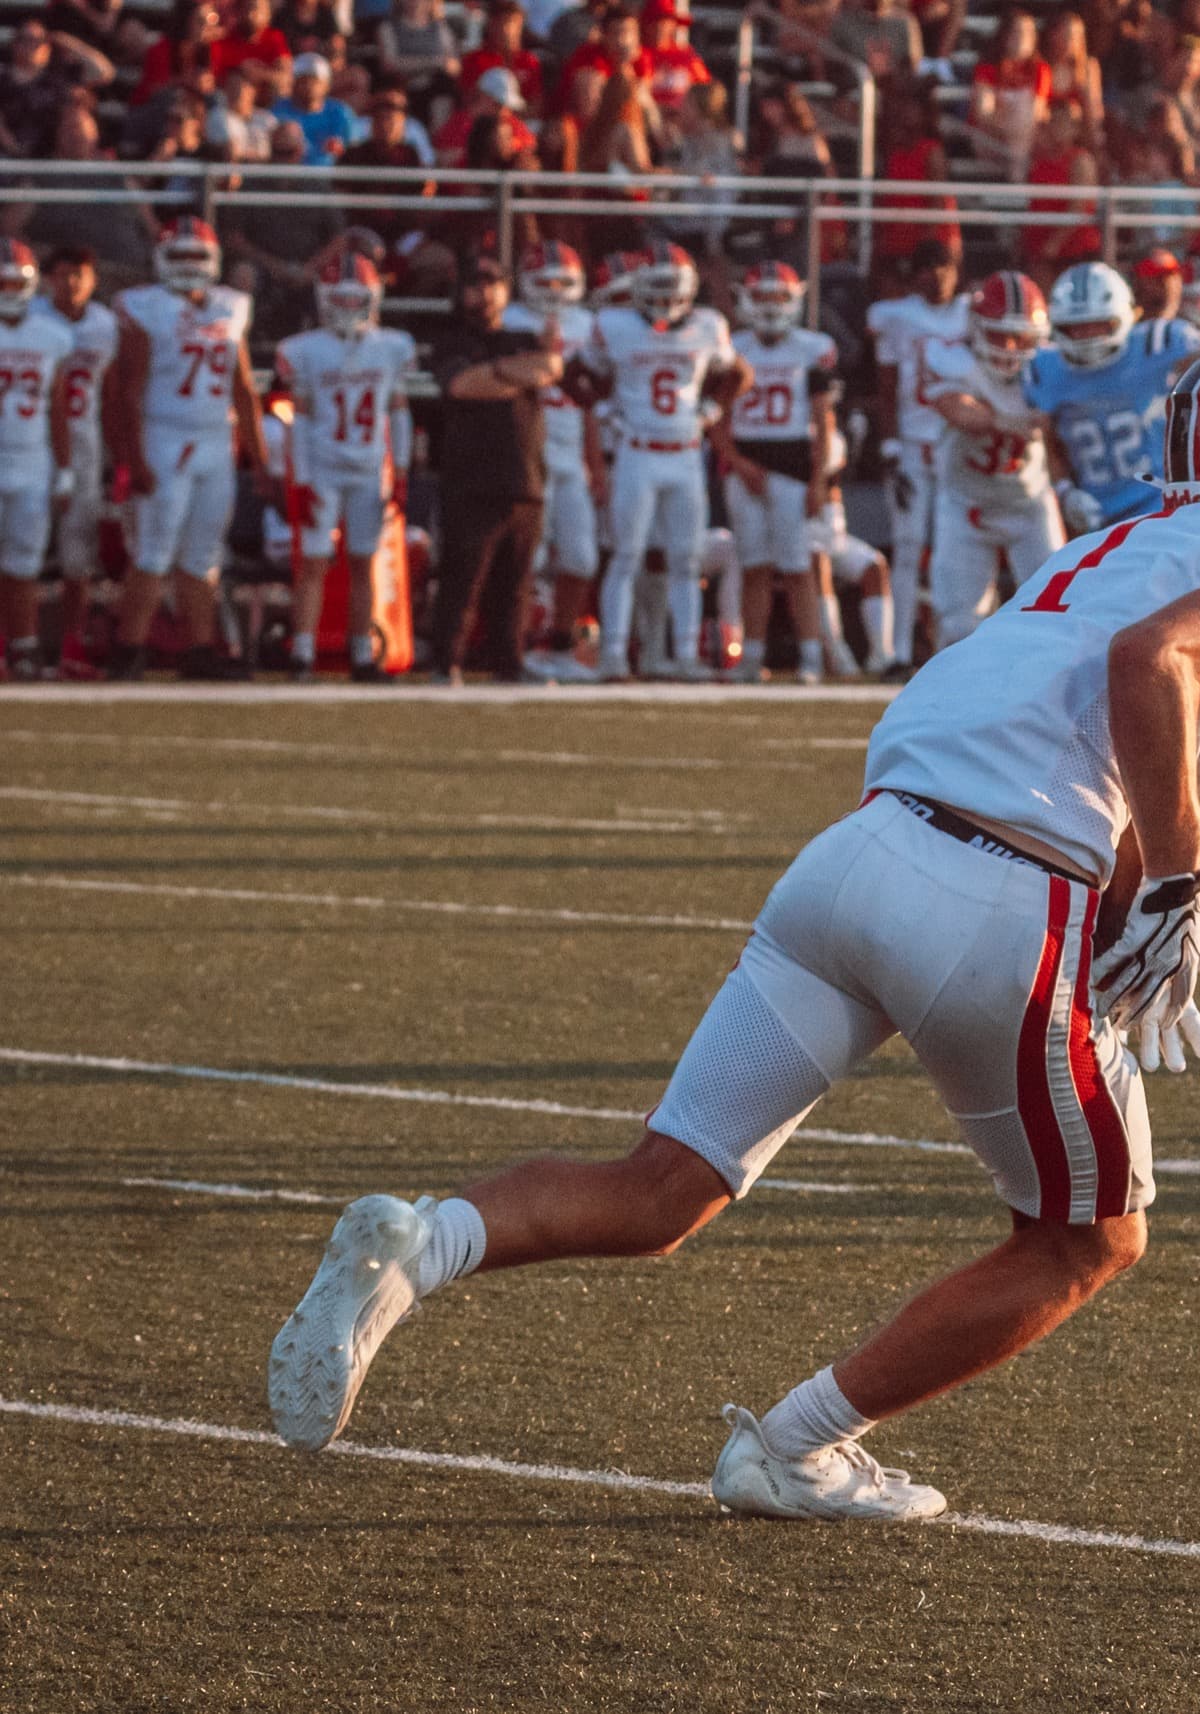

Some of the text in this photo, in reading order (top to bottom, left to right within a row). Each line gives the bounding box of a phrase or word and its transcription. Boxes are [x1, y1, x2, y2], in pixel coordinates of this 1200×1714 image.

[333, 388, 376, 443] 14
[651, 368, 679, 416] 6
[1071, 411, 1152, 484] 22
